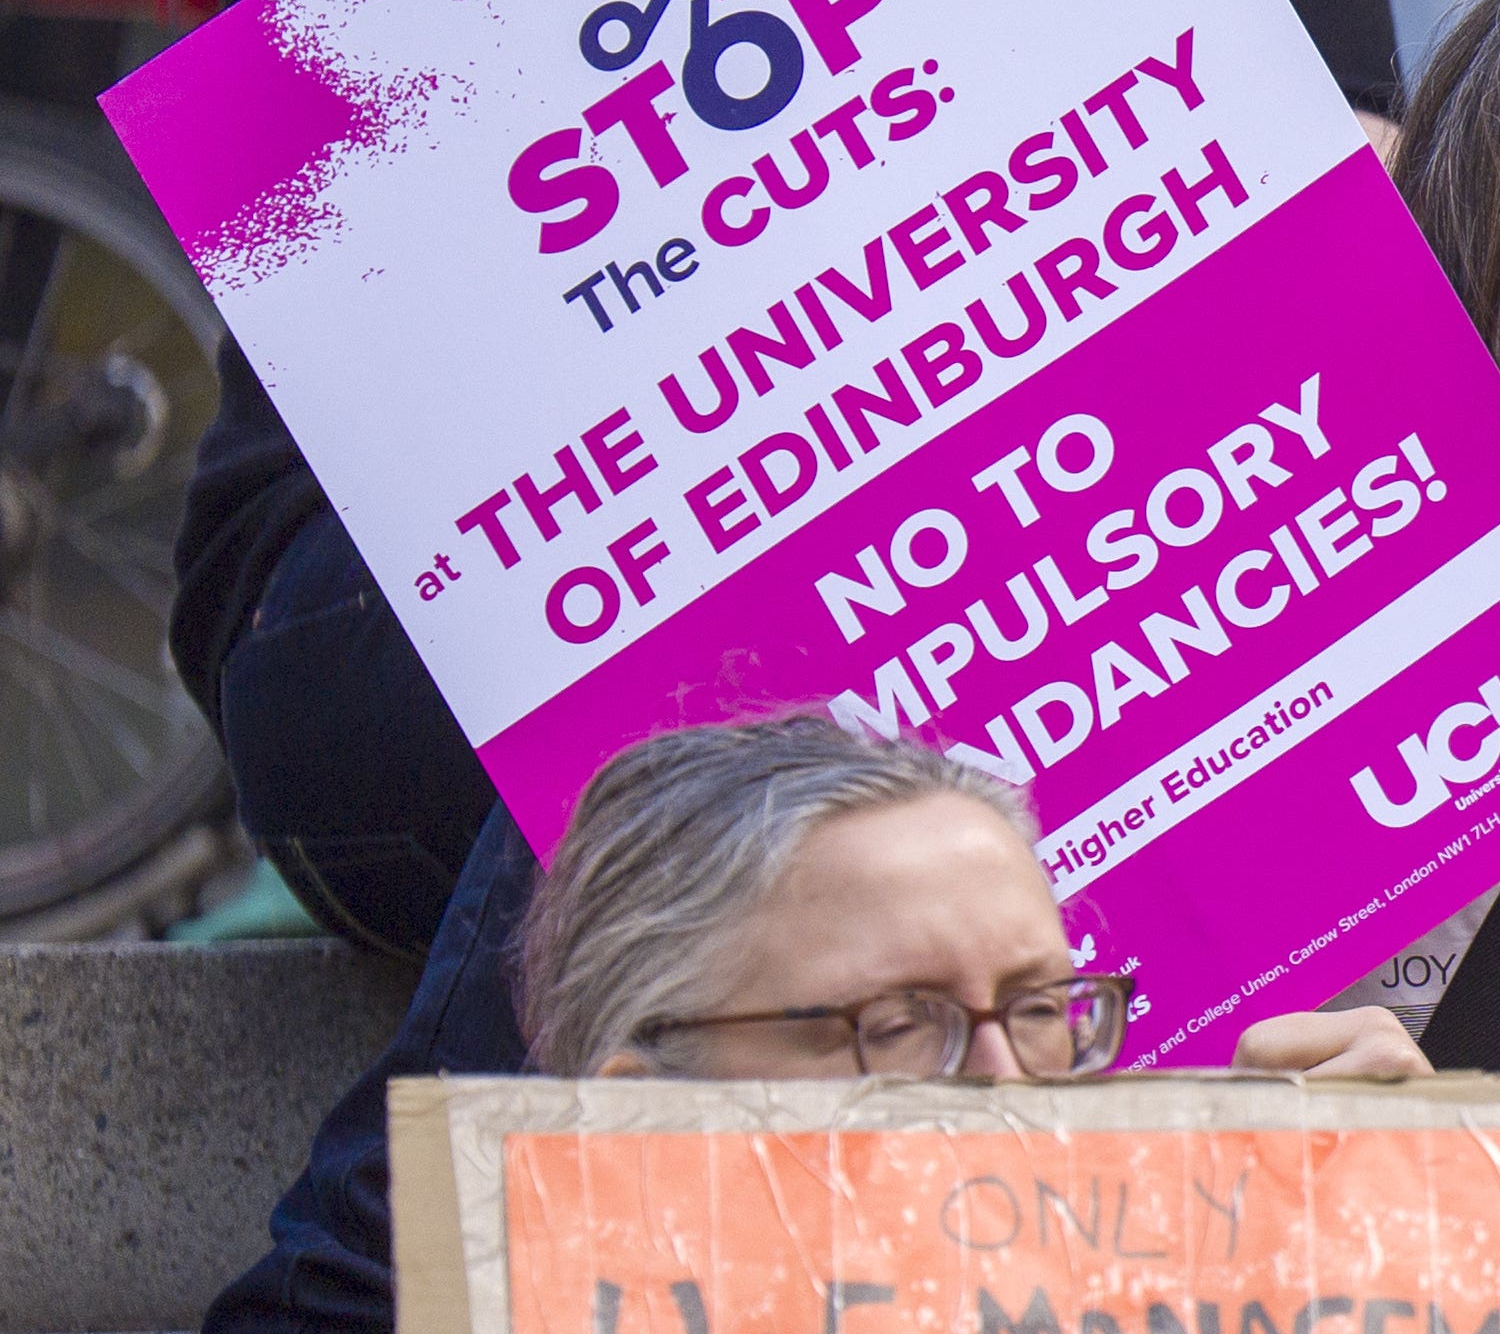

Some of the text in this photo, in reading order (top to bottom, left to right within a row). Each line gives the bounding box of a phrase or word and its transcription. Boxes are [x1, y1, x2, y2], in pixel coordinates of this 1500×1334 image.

[413, 26, 1206, 602] at THE UNIVERSITY
[562, 58, 955, 334] The CUTS:
[545, 139, 1249, 644] OF EDINBURGH
[814, 413, 1115, 644] NO TO
[827, 372, 1331, 739] MPULSORY
[946, 432, 1448, 787] NDANCIES!
[1042, 677, 1334, 884] Higher Education
[1159, 1029, 1187, 1055] and
[1186, 993, 1241, 1034] College
[1240, 963, 1290, 997] Union,
[1288, 927, 1338, 966] Carlow
[1338, 897, 1386, 932] Street,
[1384, 860, 1438, 900] London
[1437, 834, 1471, 864] NW1
[1470, 812, 1500, 840] 7LH
[1381, 953, 1456, 988] JOY
[940, 1171, 1248, 1260] ONLY
